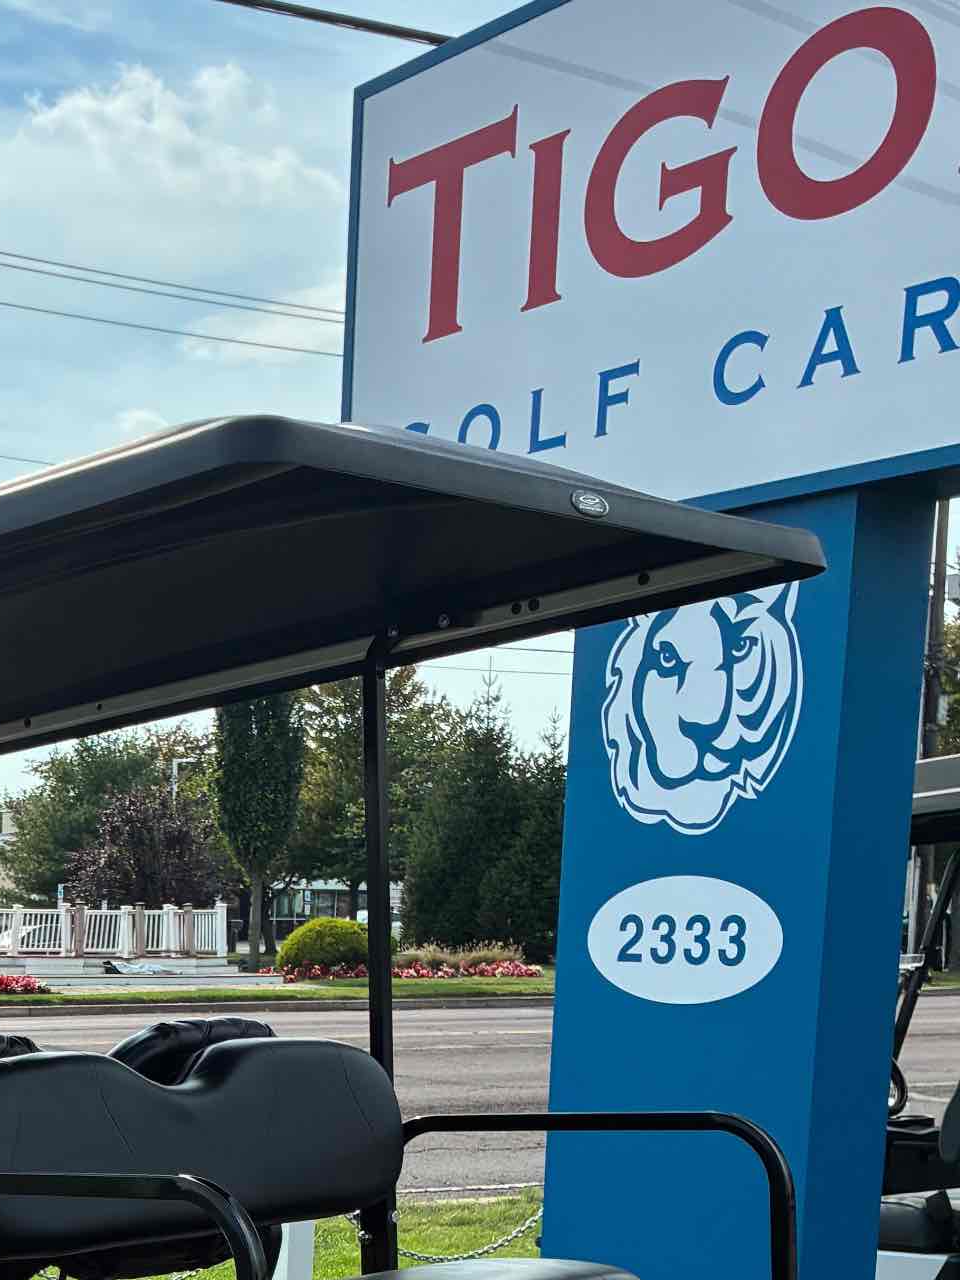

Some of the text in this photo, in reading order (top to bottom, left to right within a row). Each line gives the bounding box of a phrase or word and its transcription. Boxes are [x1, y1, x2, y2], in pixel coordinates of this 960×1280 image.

[387, 6, 960, 344] TIGO
[404, 276, 960, 455] OLF CAR
[617, 913, 747, 967] 2333
